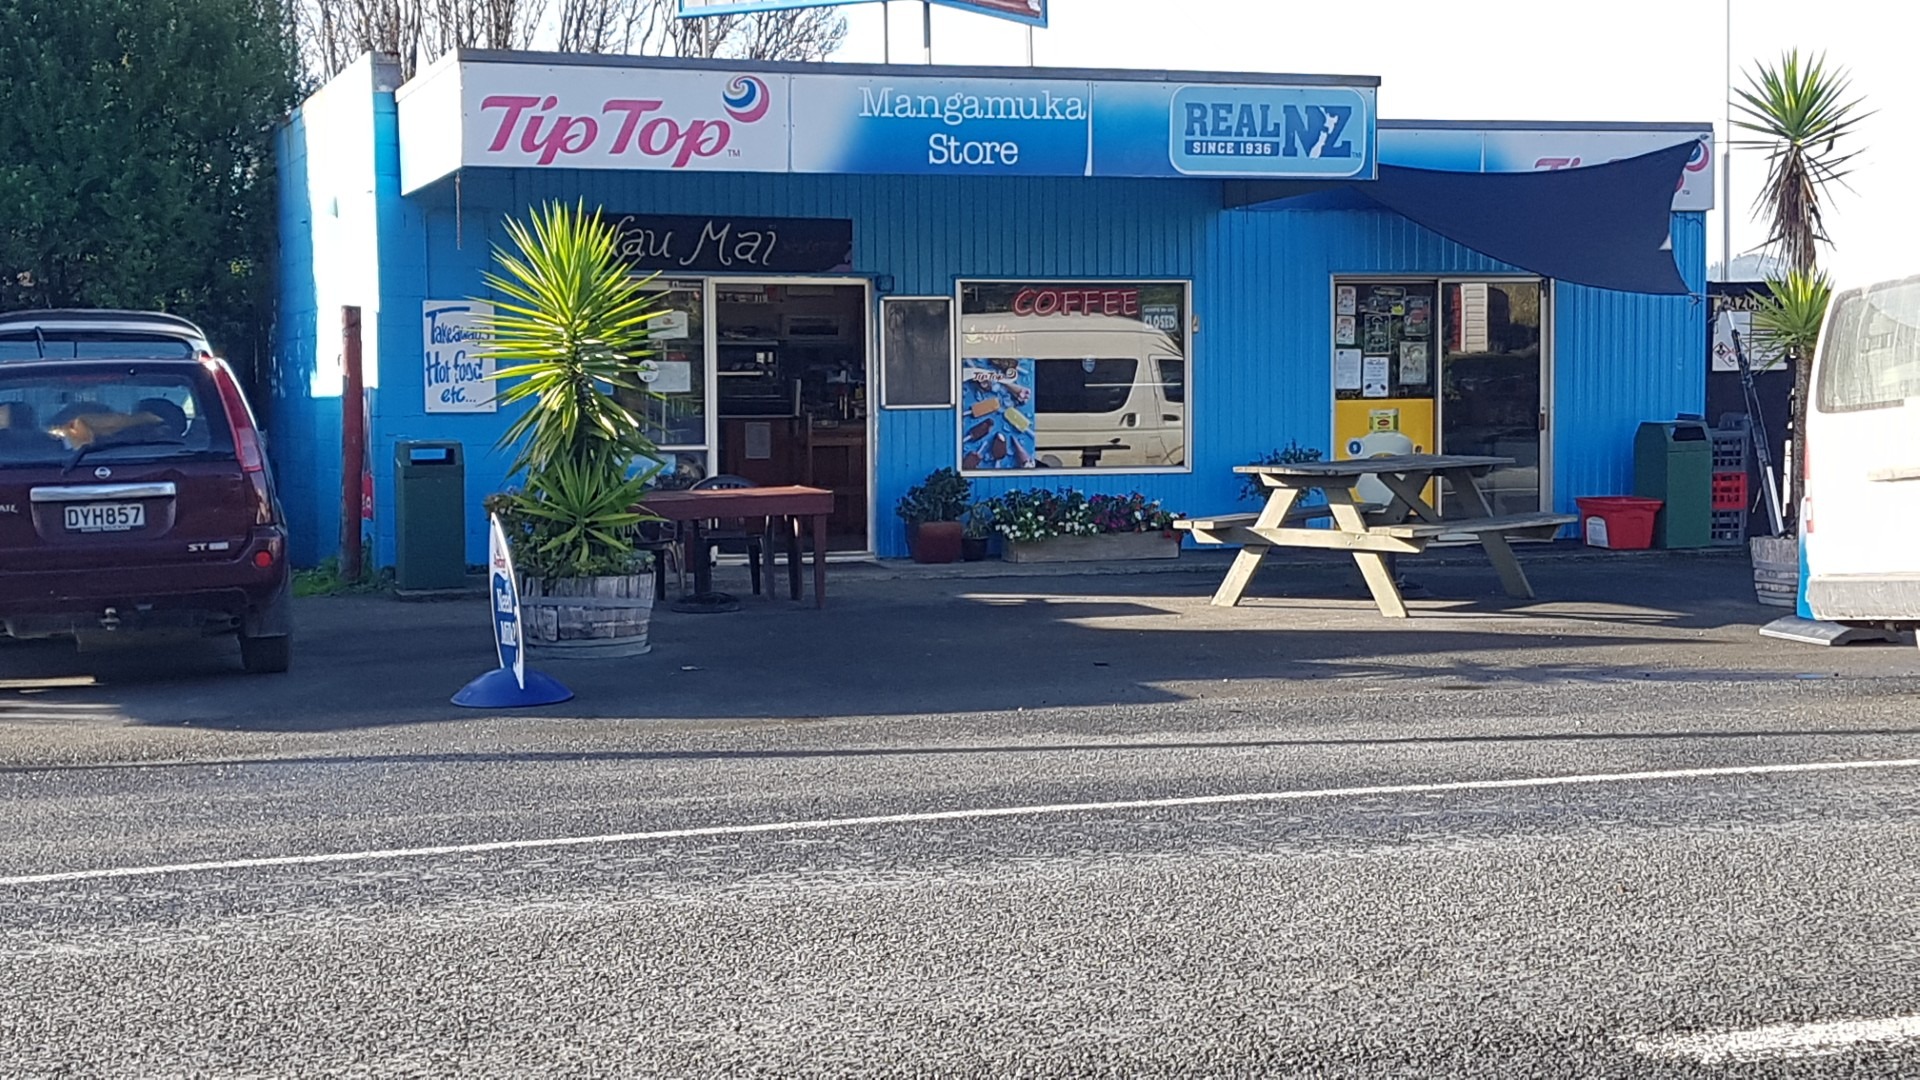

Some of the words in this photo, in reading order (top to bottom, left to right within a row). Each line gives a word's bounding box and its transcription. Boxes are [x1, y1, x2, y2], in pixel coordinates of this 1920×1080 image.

[858, 86, 1087, 125] Mangamuka
[481, 95, 598, 165] Tip
[603, 99, 731, 168] Top
[1184, 102, 1280, 138] REAL
[1282, 105, 1352, 158] NZ
[929, 132, 1019, 165] Store
[1193, 141, 1235, 155] SINCE
[1239, 142, 1272, 155] 1936
[679, 220, 777, 266] Mai
[1013, 287, 1139, 316] COFFEE
[1144, 314, 1176, 329] CLOSED
[426, 351, 452, 388] Hot
[453, 350, 485, 384] food
[67, 506, 141, 526] DYH857
[188, 543, 207, 552] ST
